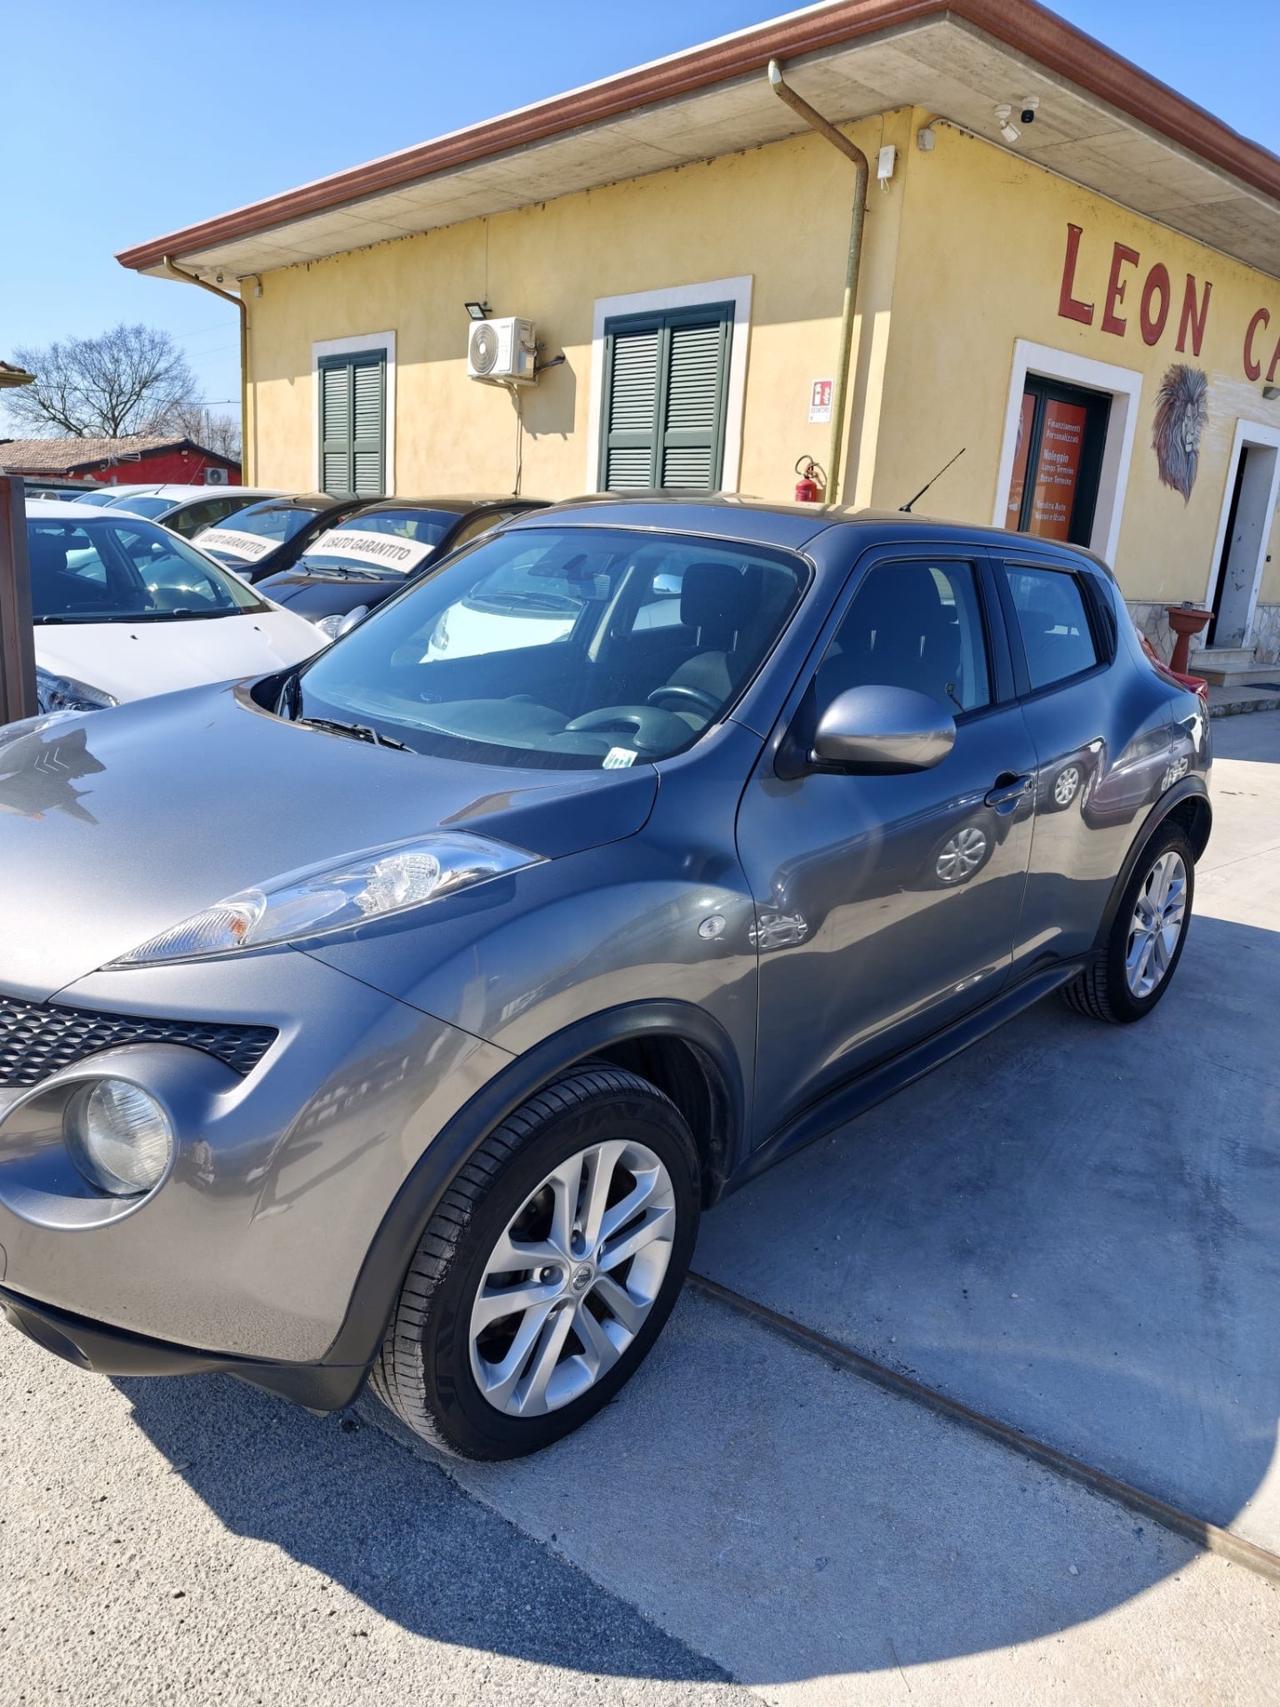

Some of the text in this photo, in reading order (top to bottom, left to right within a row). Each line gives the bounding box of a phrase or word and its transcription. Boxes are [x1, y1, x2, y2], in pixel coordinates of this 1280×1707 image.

[1058, 223, 1213, 356] LEON
[1043, 448, 1069, 463] Noleggio
[220, 535, 268, 554] GARANTITO
[322, 536, 412, 561] USATO GARANTITO
